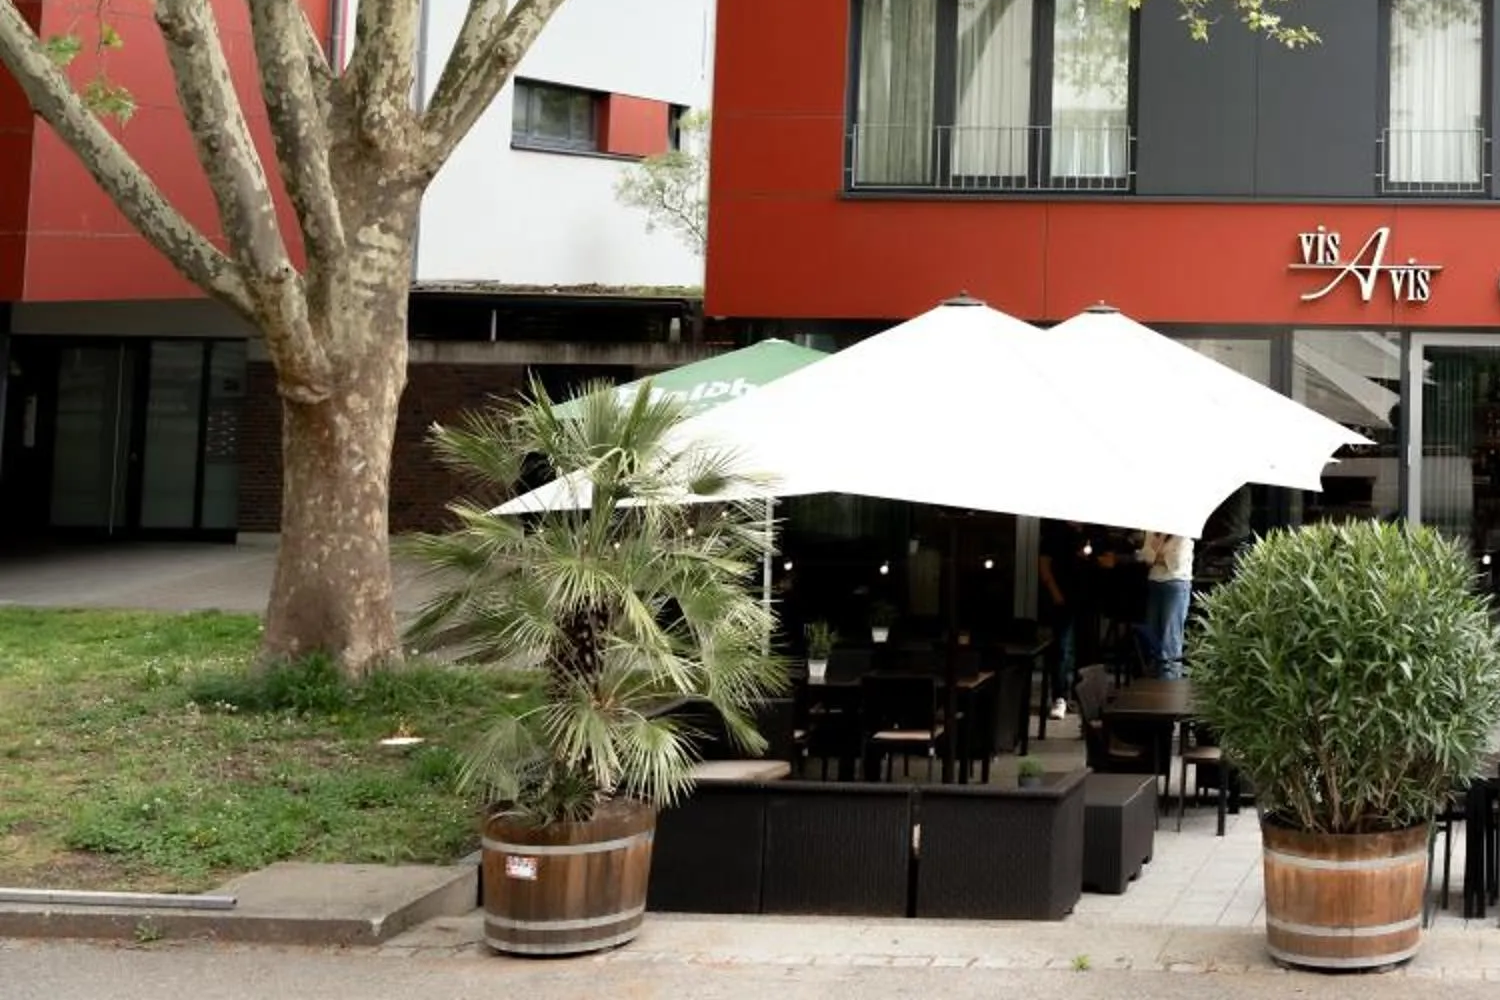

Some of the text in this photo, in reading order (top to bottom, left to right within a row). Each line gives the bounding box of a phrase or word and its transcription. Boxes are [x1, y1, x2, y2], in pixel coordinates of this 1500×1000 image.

[1298, 225, 1431, 301] vis A vis
